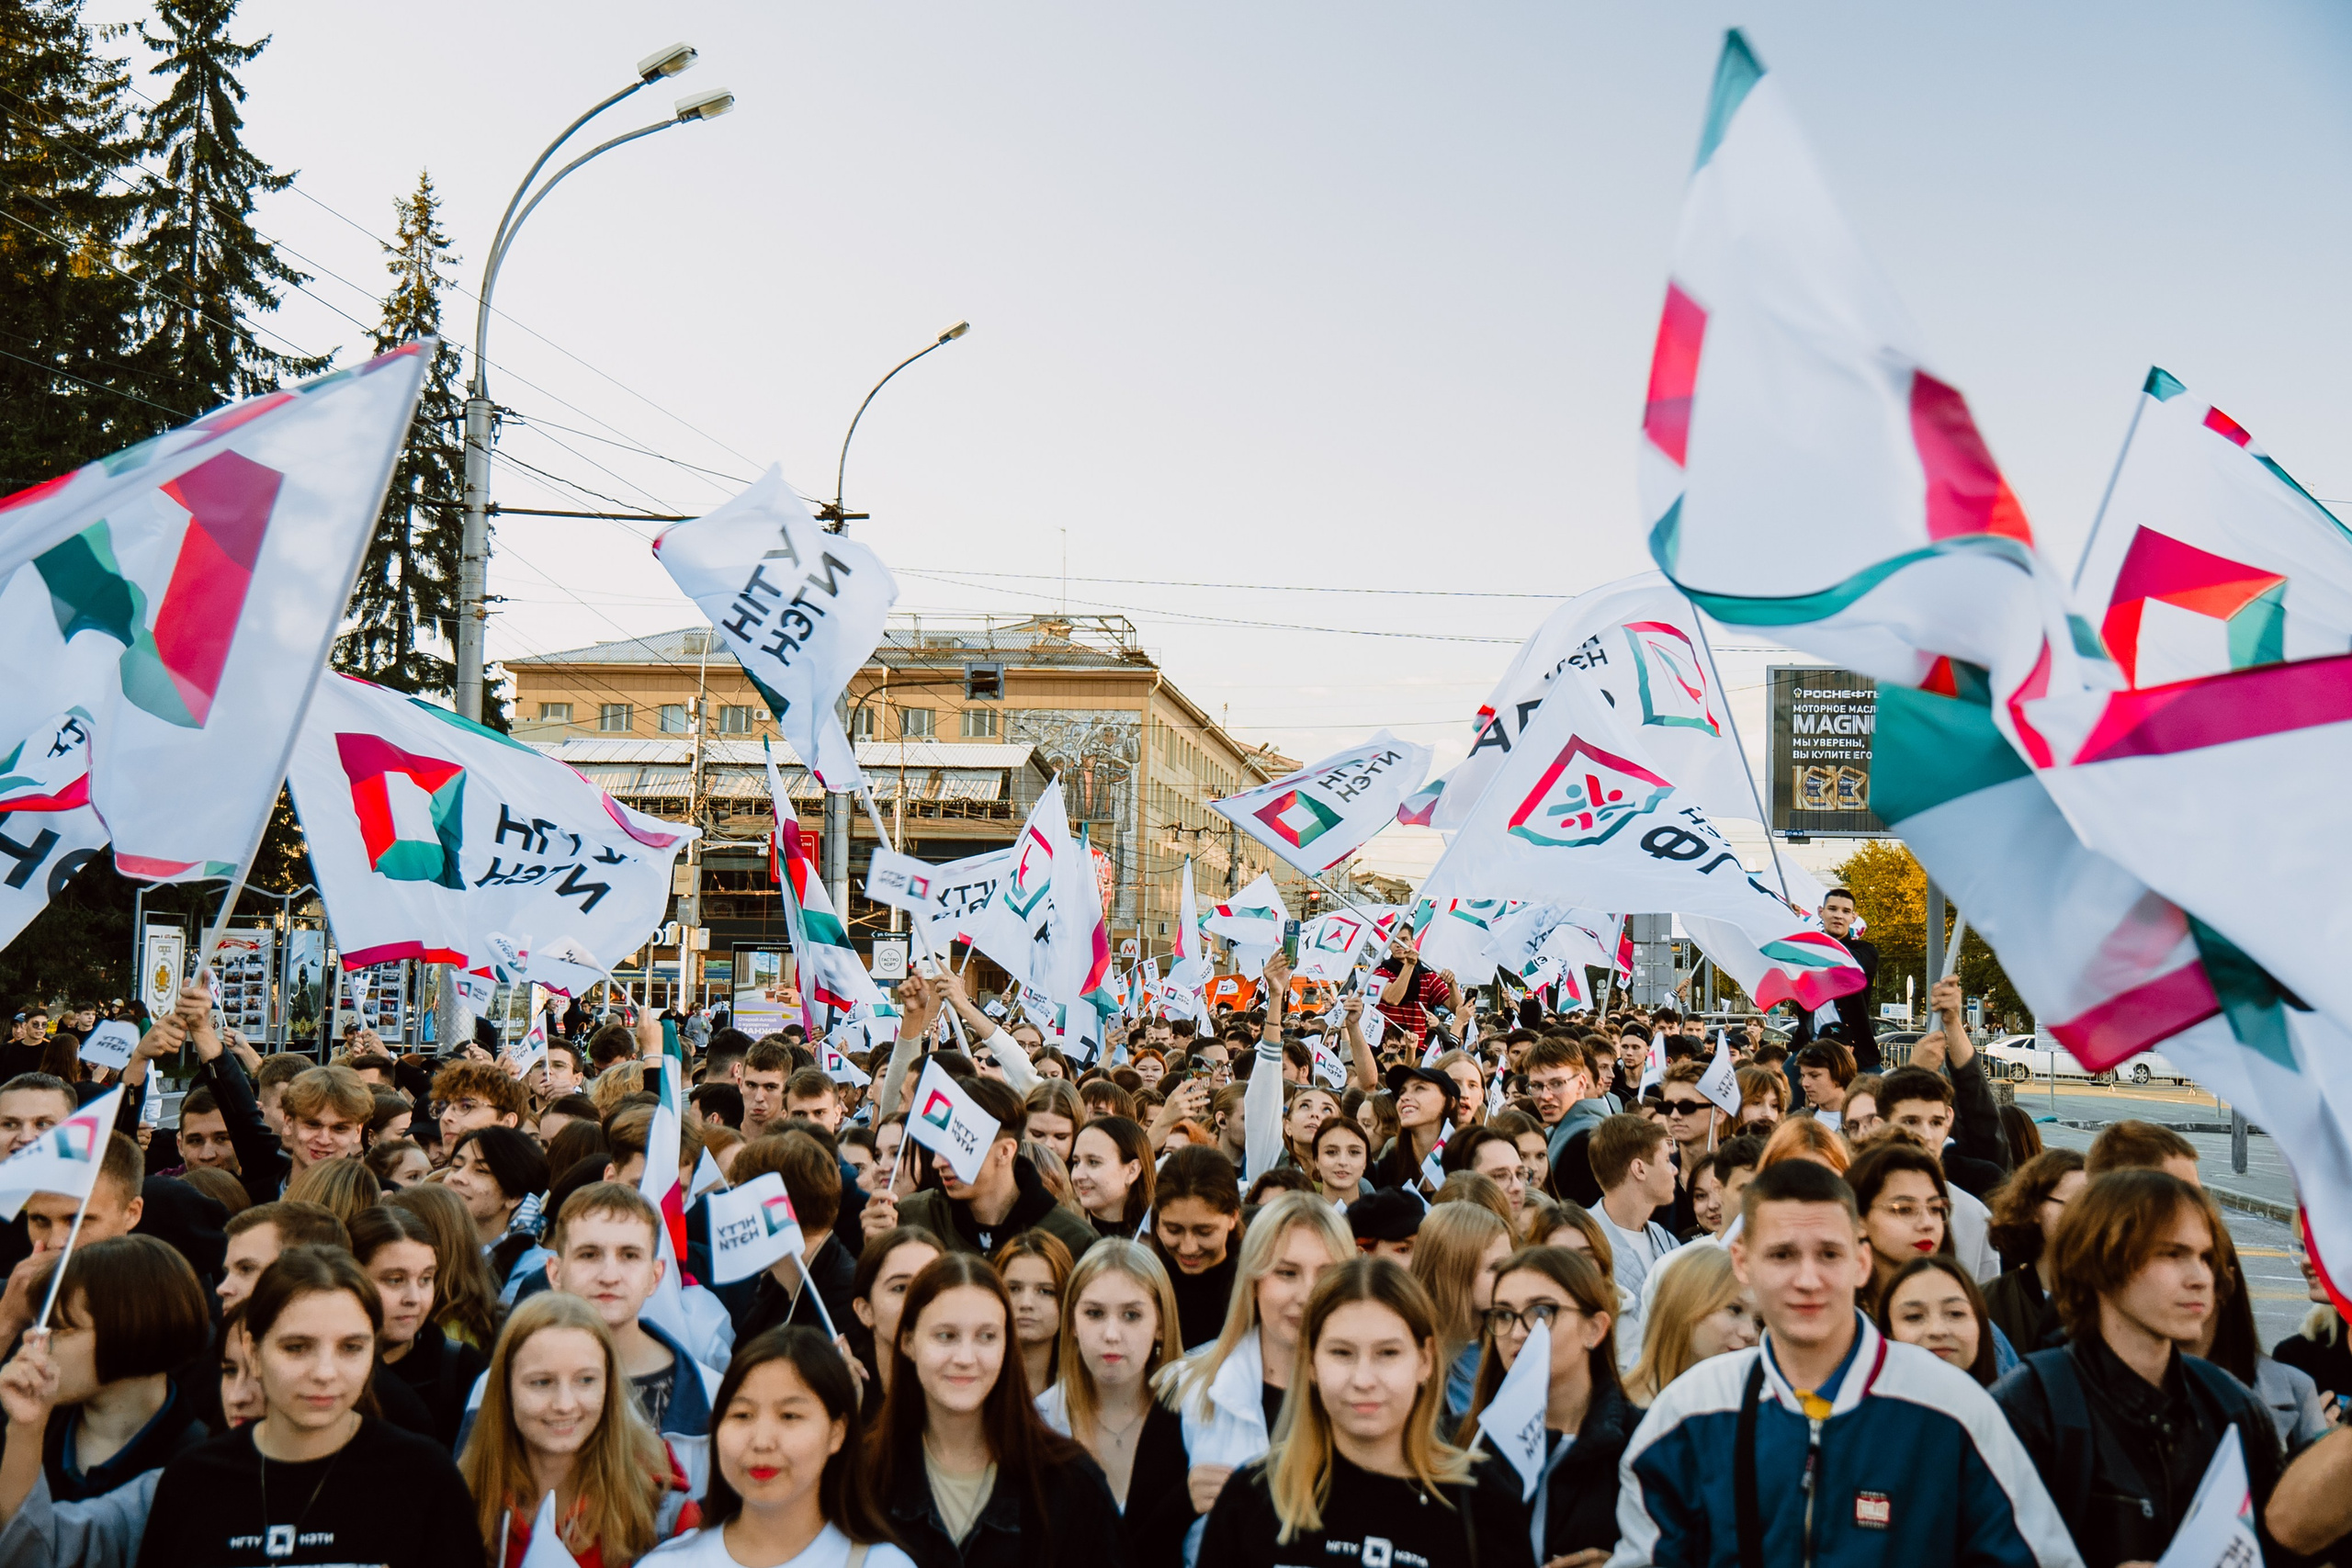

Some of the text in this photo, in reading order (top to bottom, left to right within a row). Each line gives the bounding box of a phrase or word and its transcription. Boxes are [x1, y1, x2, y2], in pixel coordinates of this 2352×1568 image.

[760, 551, 853, 668] НЭТИ
[1792, 705, 1880, 714] МОТОРНОЕ МАСЛ
[1792, 739, 1865, 749] МЫ УВЕРЕНЫ,
[1792, 750, 1872, 760] ВЫ КУПИТЕ ЕГО
[1336, 750, 1403, 803] НЭТИ
[952, 1127, 975, 1156] НЭТИ
[954, 1116, 978, 1143] НГТУ
[231, 1533, 334, 1549] НГТУ НЭТИ
[1326, 1540, 1429, 1568] НГТУ НЭТИ
